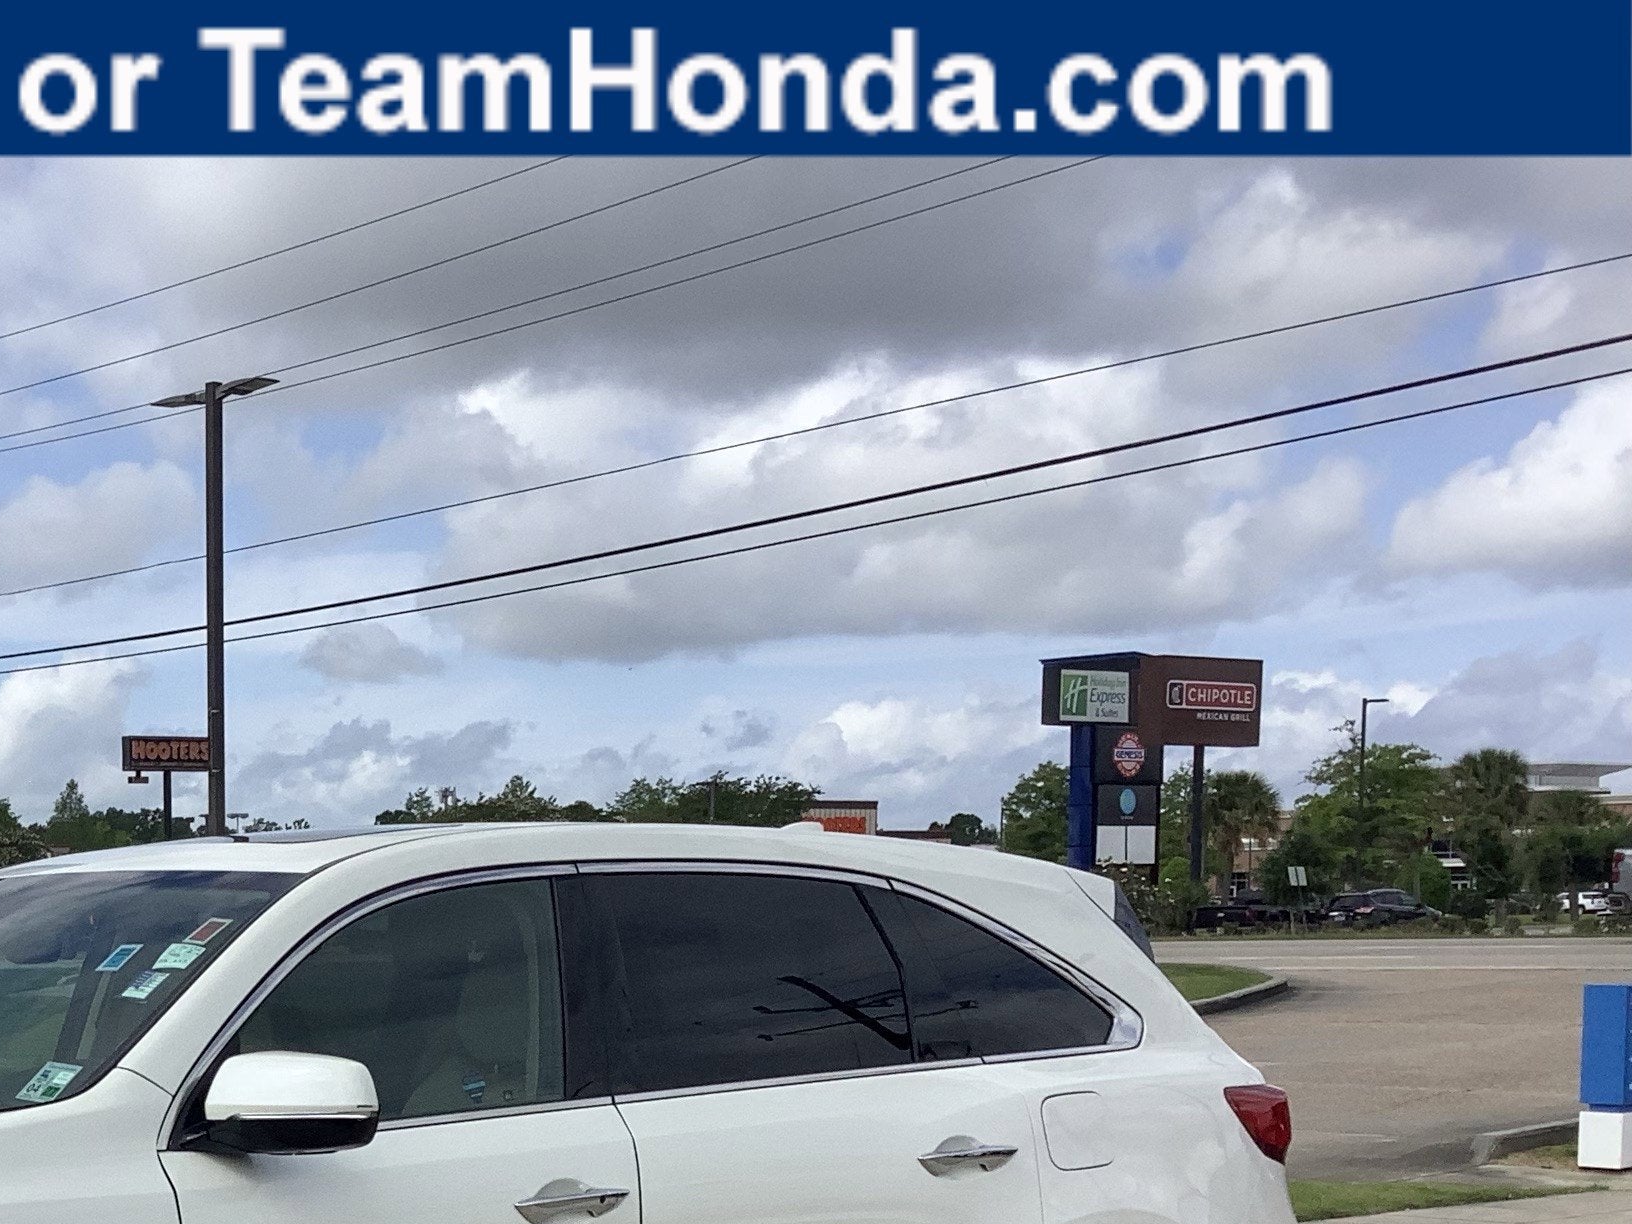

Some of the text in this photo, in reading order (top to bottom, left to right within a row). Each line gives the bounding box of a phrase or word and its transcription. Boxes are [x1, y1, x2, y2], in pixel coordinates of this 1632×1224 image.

[1090, 688, 1127, 706] Express
[1188, 688, 1252, 705] CHIPOTLE
[1196, 712, 1250, 722] MEXICAN GRILL
[131, 740, 209, 760] HOOTERS
